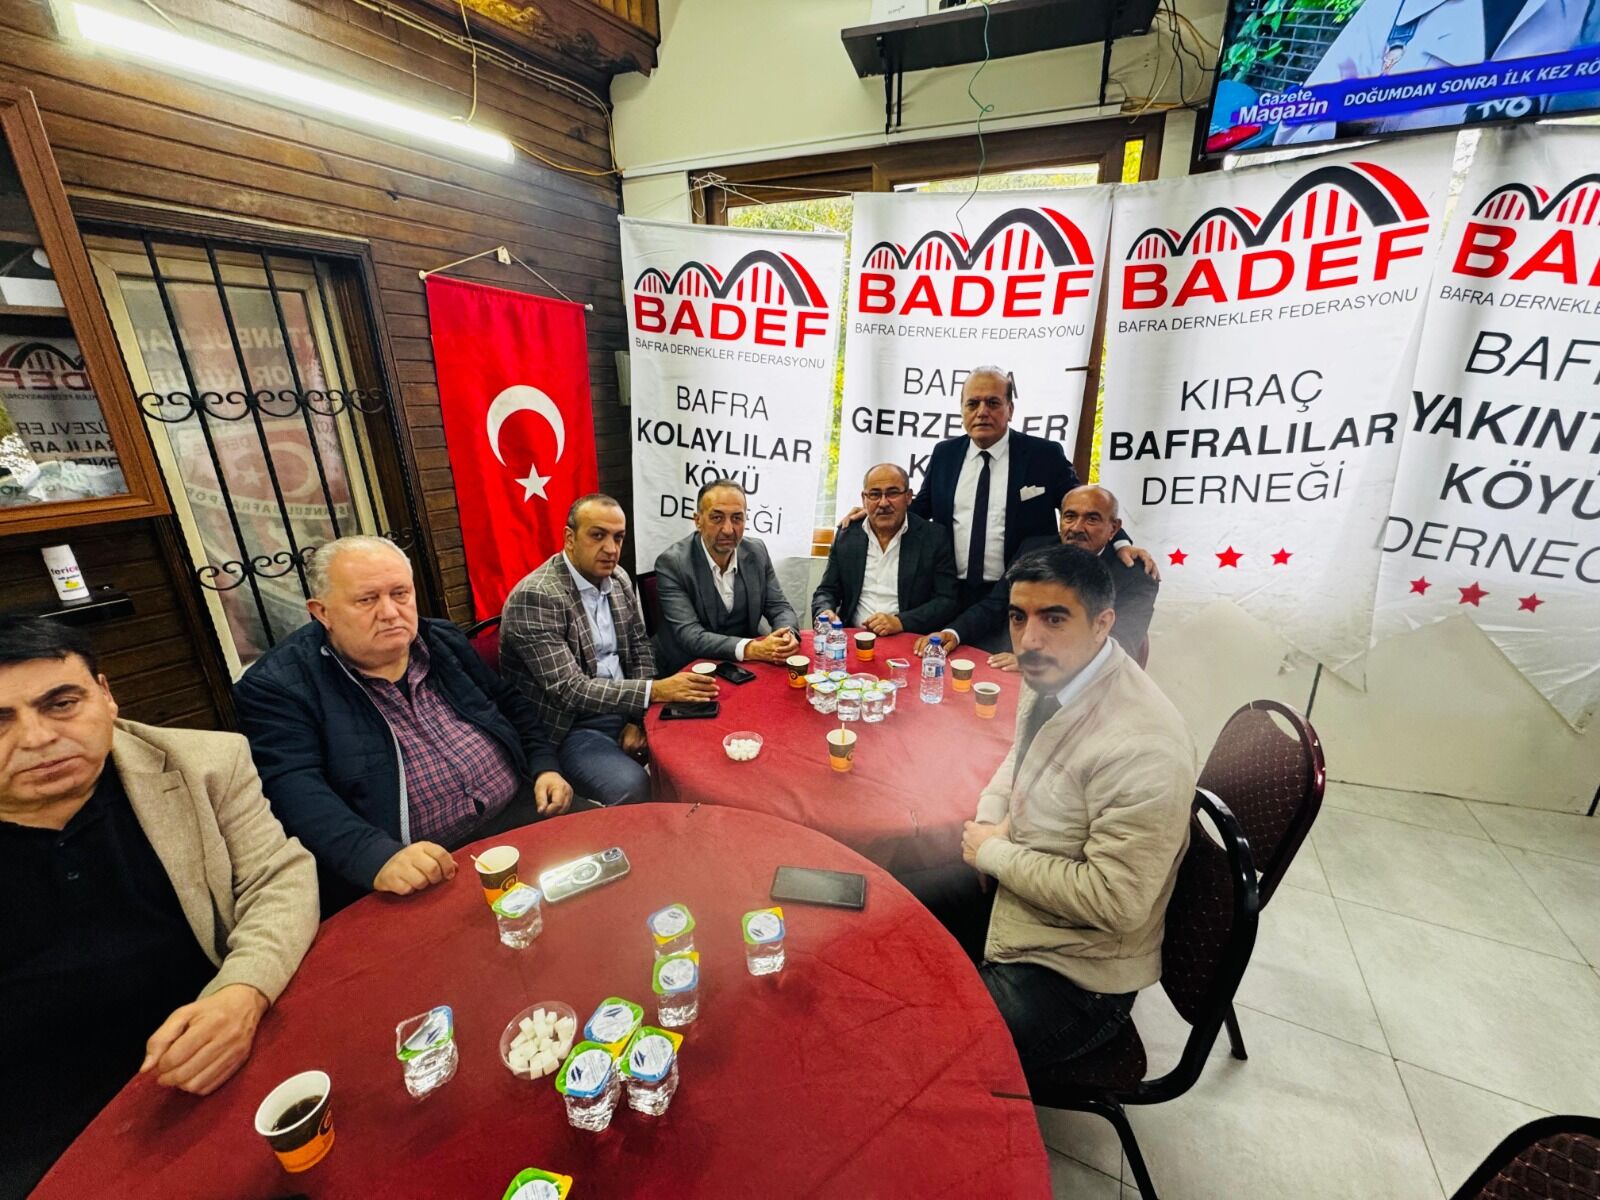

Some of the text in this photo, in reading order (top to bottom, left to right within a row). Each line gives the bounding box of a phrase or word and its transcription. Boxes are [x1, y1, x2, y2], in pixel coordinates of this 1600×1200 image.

[1259, 87, 1313, 107] Gazete
[1344, 81, 1436, 107] DOĞUMDAN
[1439, 74, 1498, 94] SONRA
[1502, 68, 1535, 86] İLK
[1536, 64, 1574, 81] KEZ
[1238, 96, 1329, 126] Magazin
[1121, 223, 1430, 311] BADEF
[1452, 222, 1600, 287] BA
[858, 269, 1094, 318] BADEF
[1118, 287, 1418, 334] BAFRA DERNEKLER FEDERASYONU
[1440, 285, 1494, 306] BAFRA
[633, 293, 829, 348] BADEF
[855, 322, 1085, 340] BAFRA DERNEKLER FEDERASYONU
[635, 337, 825, 370] BAFRA DERNEKLER FEDERASYONU
[1464, 331, 1600, 385] BAF
[677, 385, 769, 421] BAFRA
[1180, 369, 1323, 413] KIRAÇ
[637, 417, 812, 464] KOLAYLILAR
[1109, 412, 1398, 461] BAFRALILAR
[1141, 460, 1345, 506] DERNEĞİ
